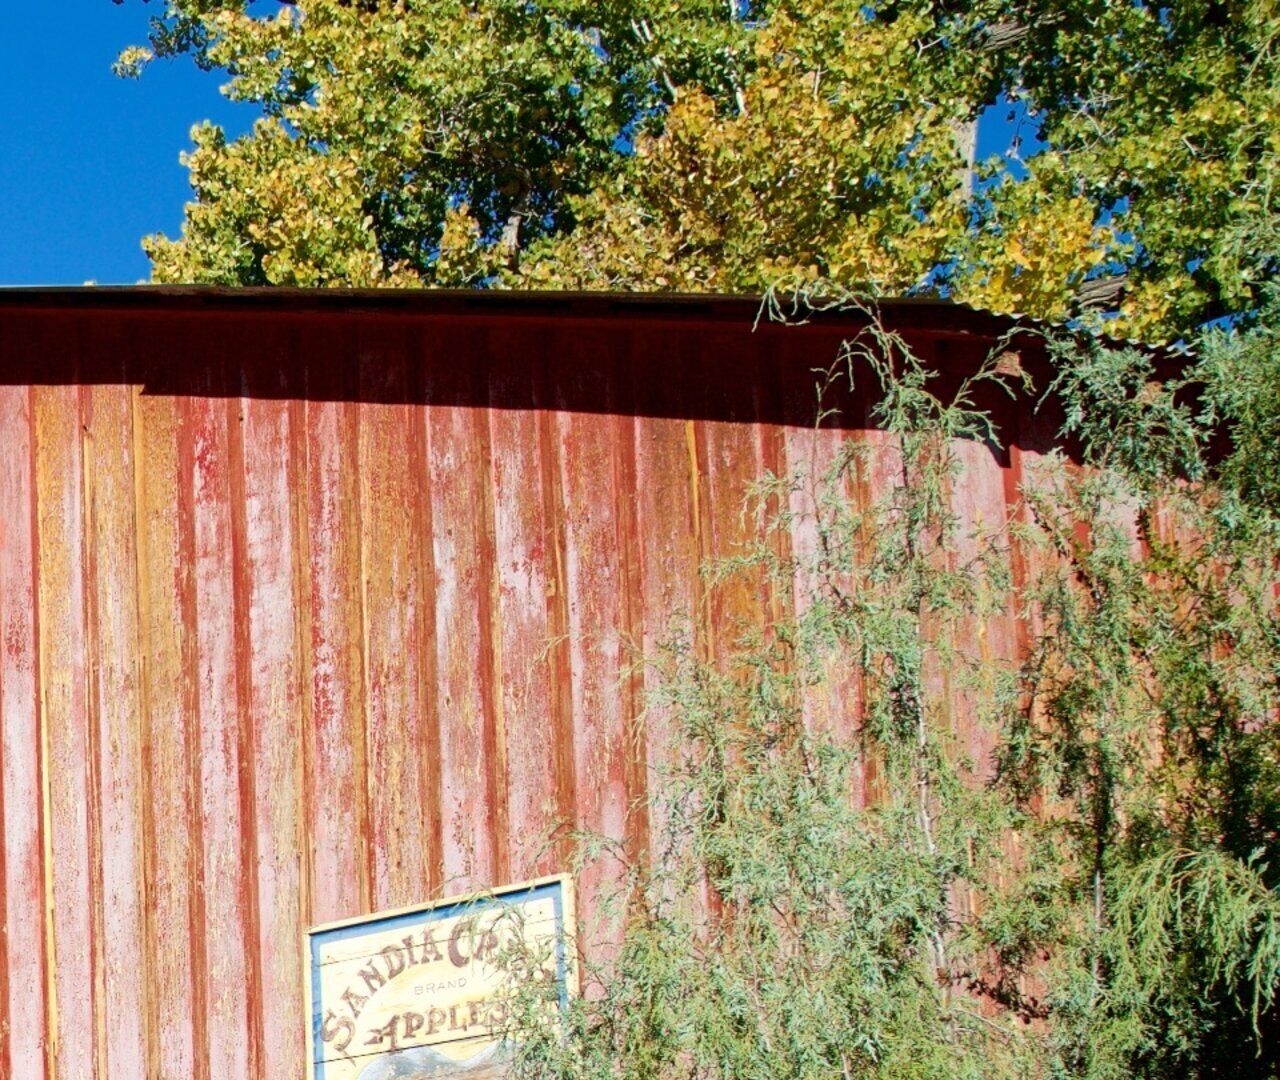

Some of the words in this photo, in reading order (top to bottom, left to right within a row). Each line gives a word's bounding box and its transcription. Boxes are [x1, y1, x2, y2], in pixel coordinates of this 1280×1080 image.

[320, 926, 444, 1054] SANDIA
[413, 976, 468, 997] BRAND
[362, 998, 509, 1056] APPLES
